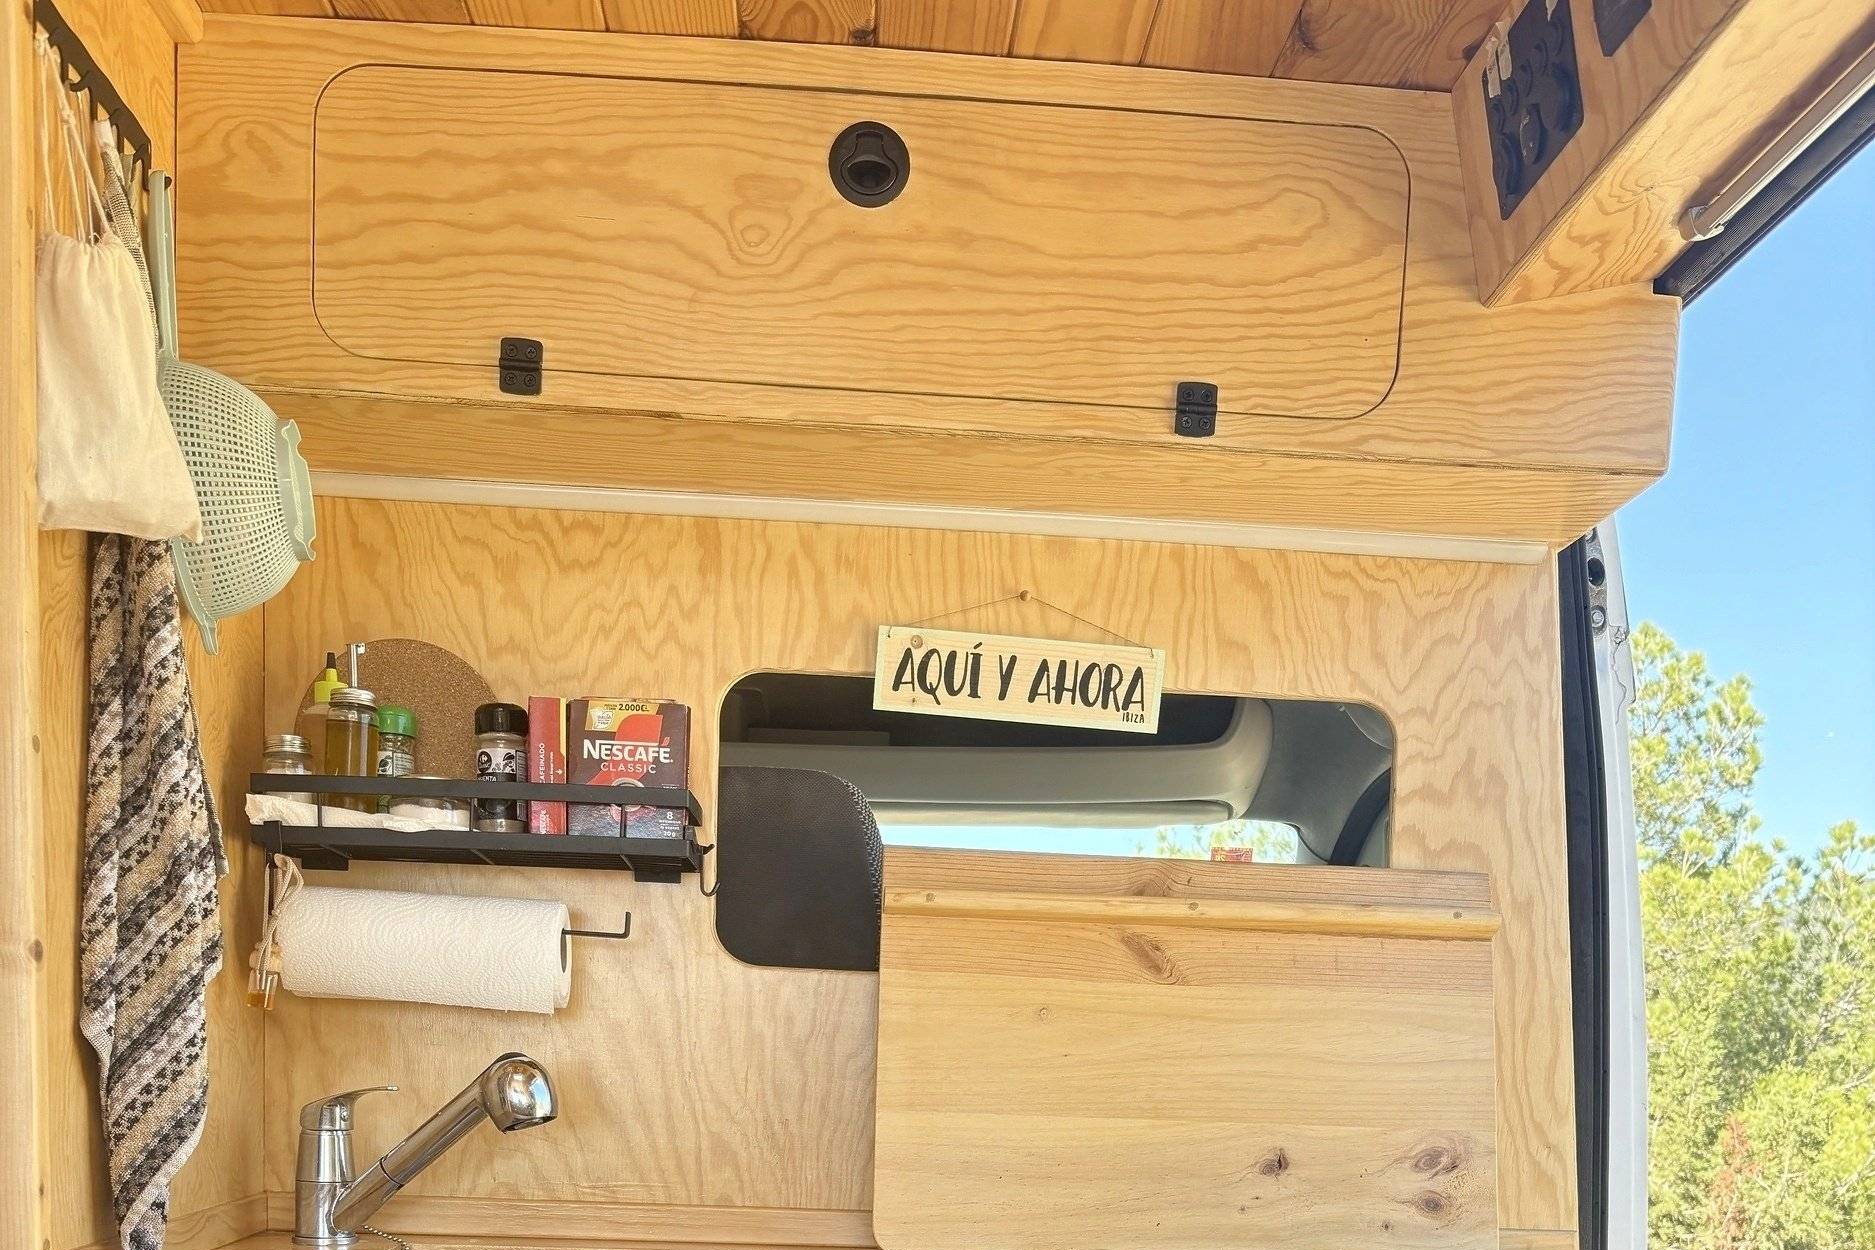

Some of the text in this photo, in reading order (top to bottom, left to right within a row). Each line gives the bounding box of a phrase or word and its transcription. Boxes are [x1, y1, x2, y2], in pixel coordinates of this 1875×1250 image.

[892, 641, 1145, 712] AQUÍ Y AHORA
[1122, 711, 1145, 724] IBIZA
[600, 762, 657, 774] CLASSIC
[666, 811, 674, 820] 8
